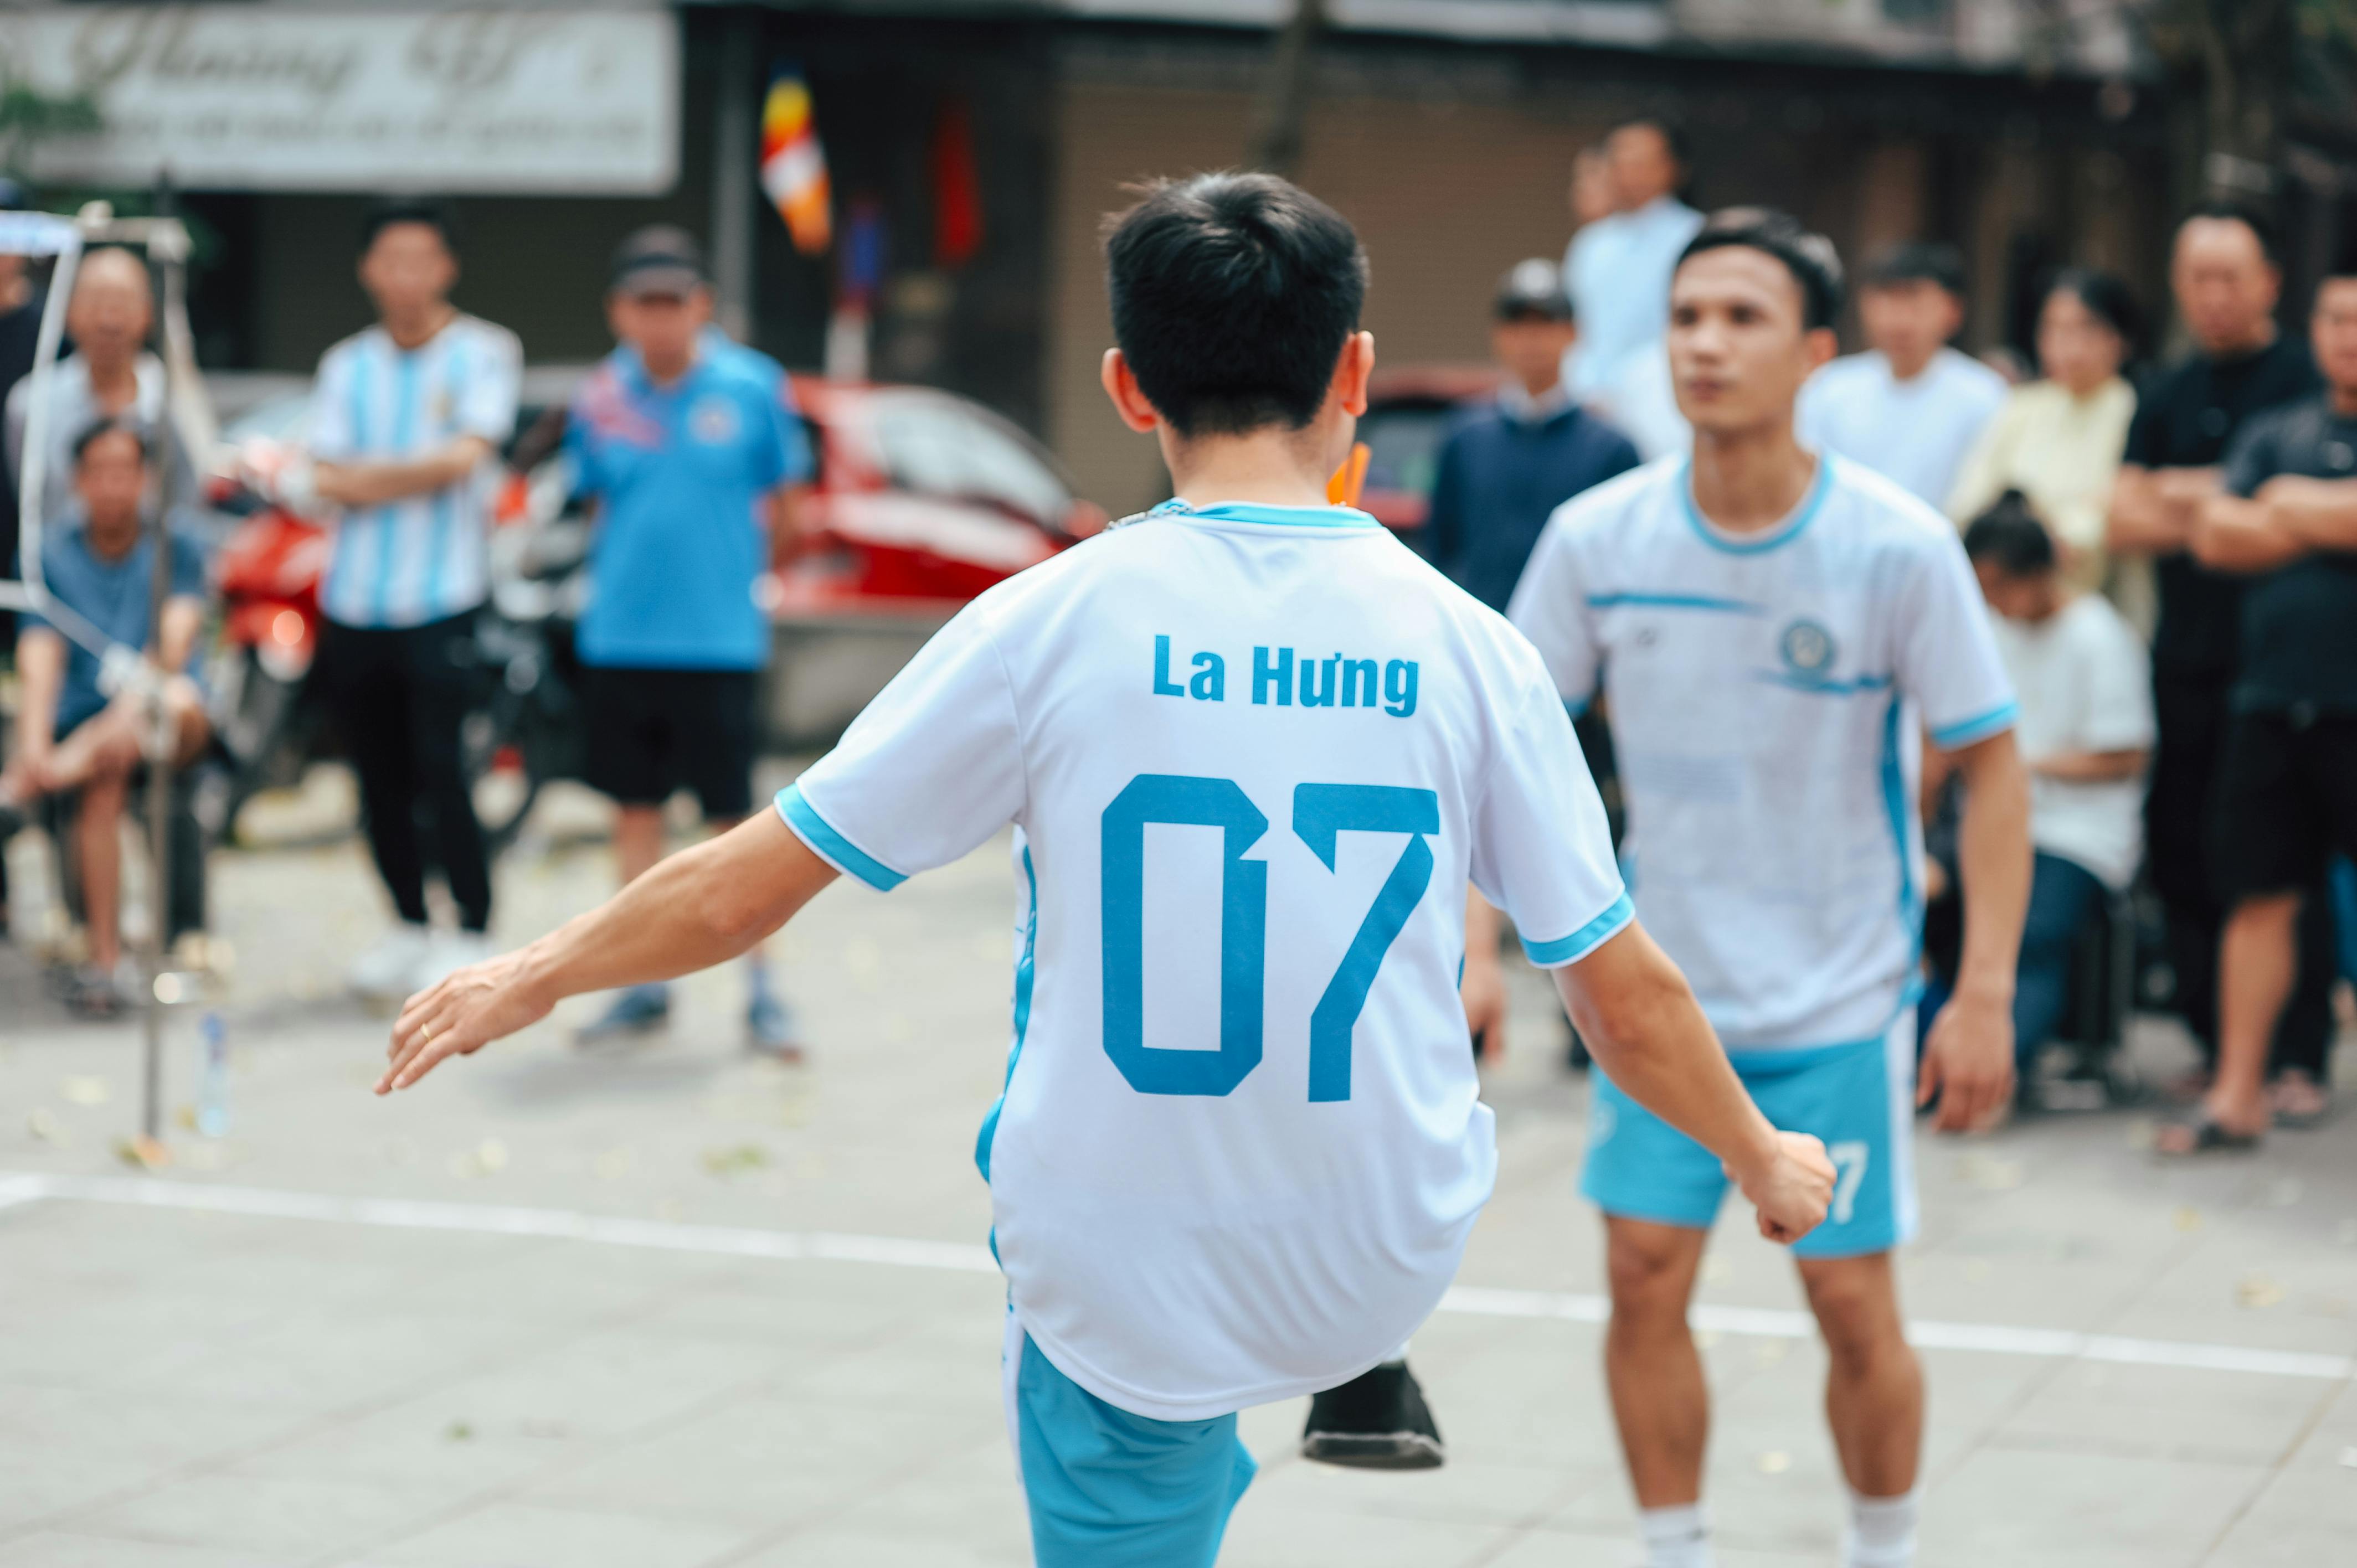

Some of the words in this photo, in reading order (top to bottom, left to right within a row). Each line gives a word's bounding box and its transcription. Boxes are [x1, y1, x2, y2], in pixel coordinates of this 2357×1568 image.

[1153, 635, 1225, 702] La
[1252, 646, 1419, 718] Hưng
[1101, 773, 1440, 1103] 07
